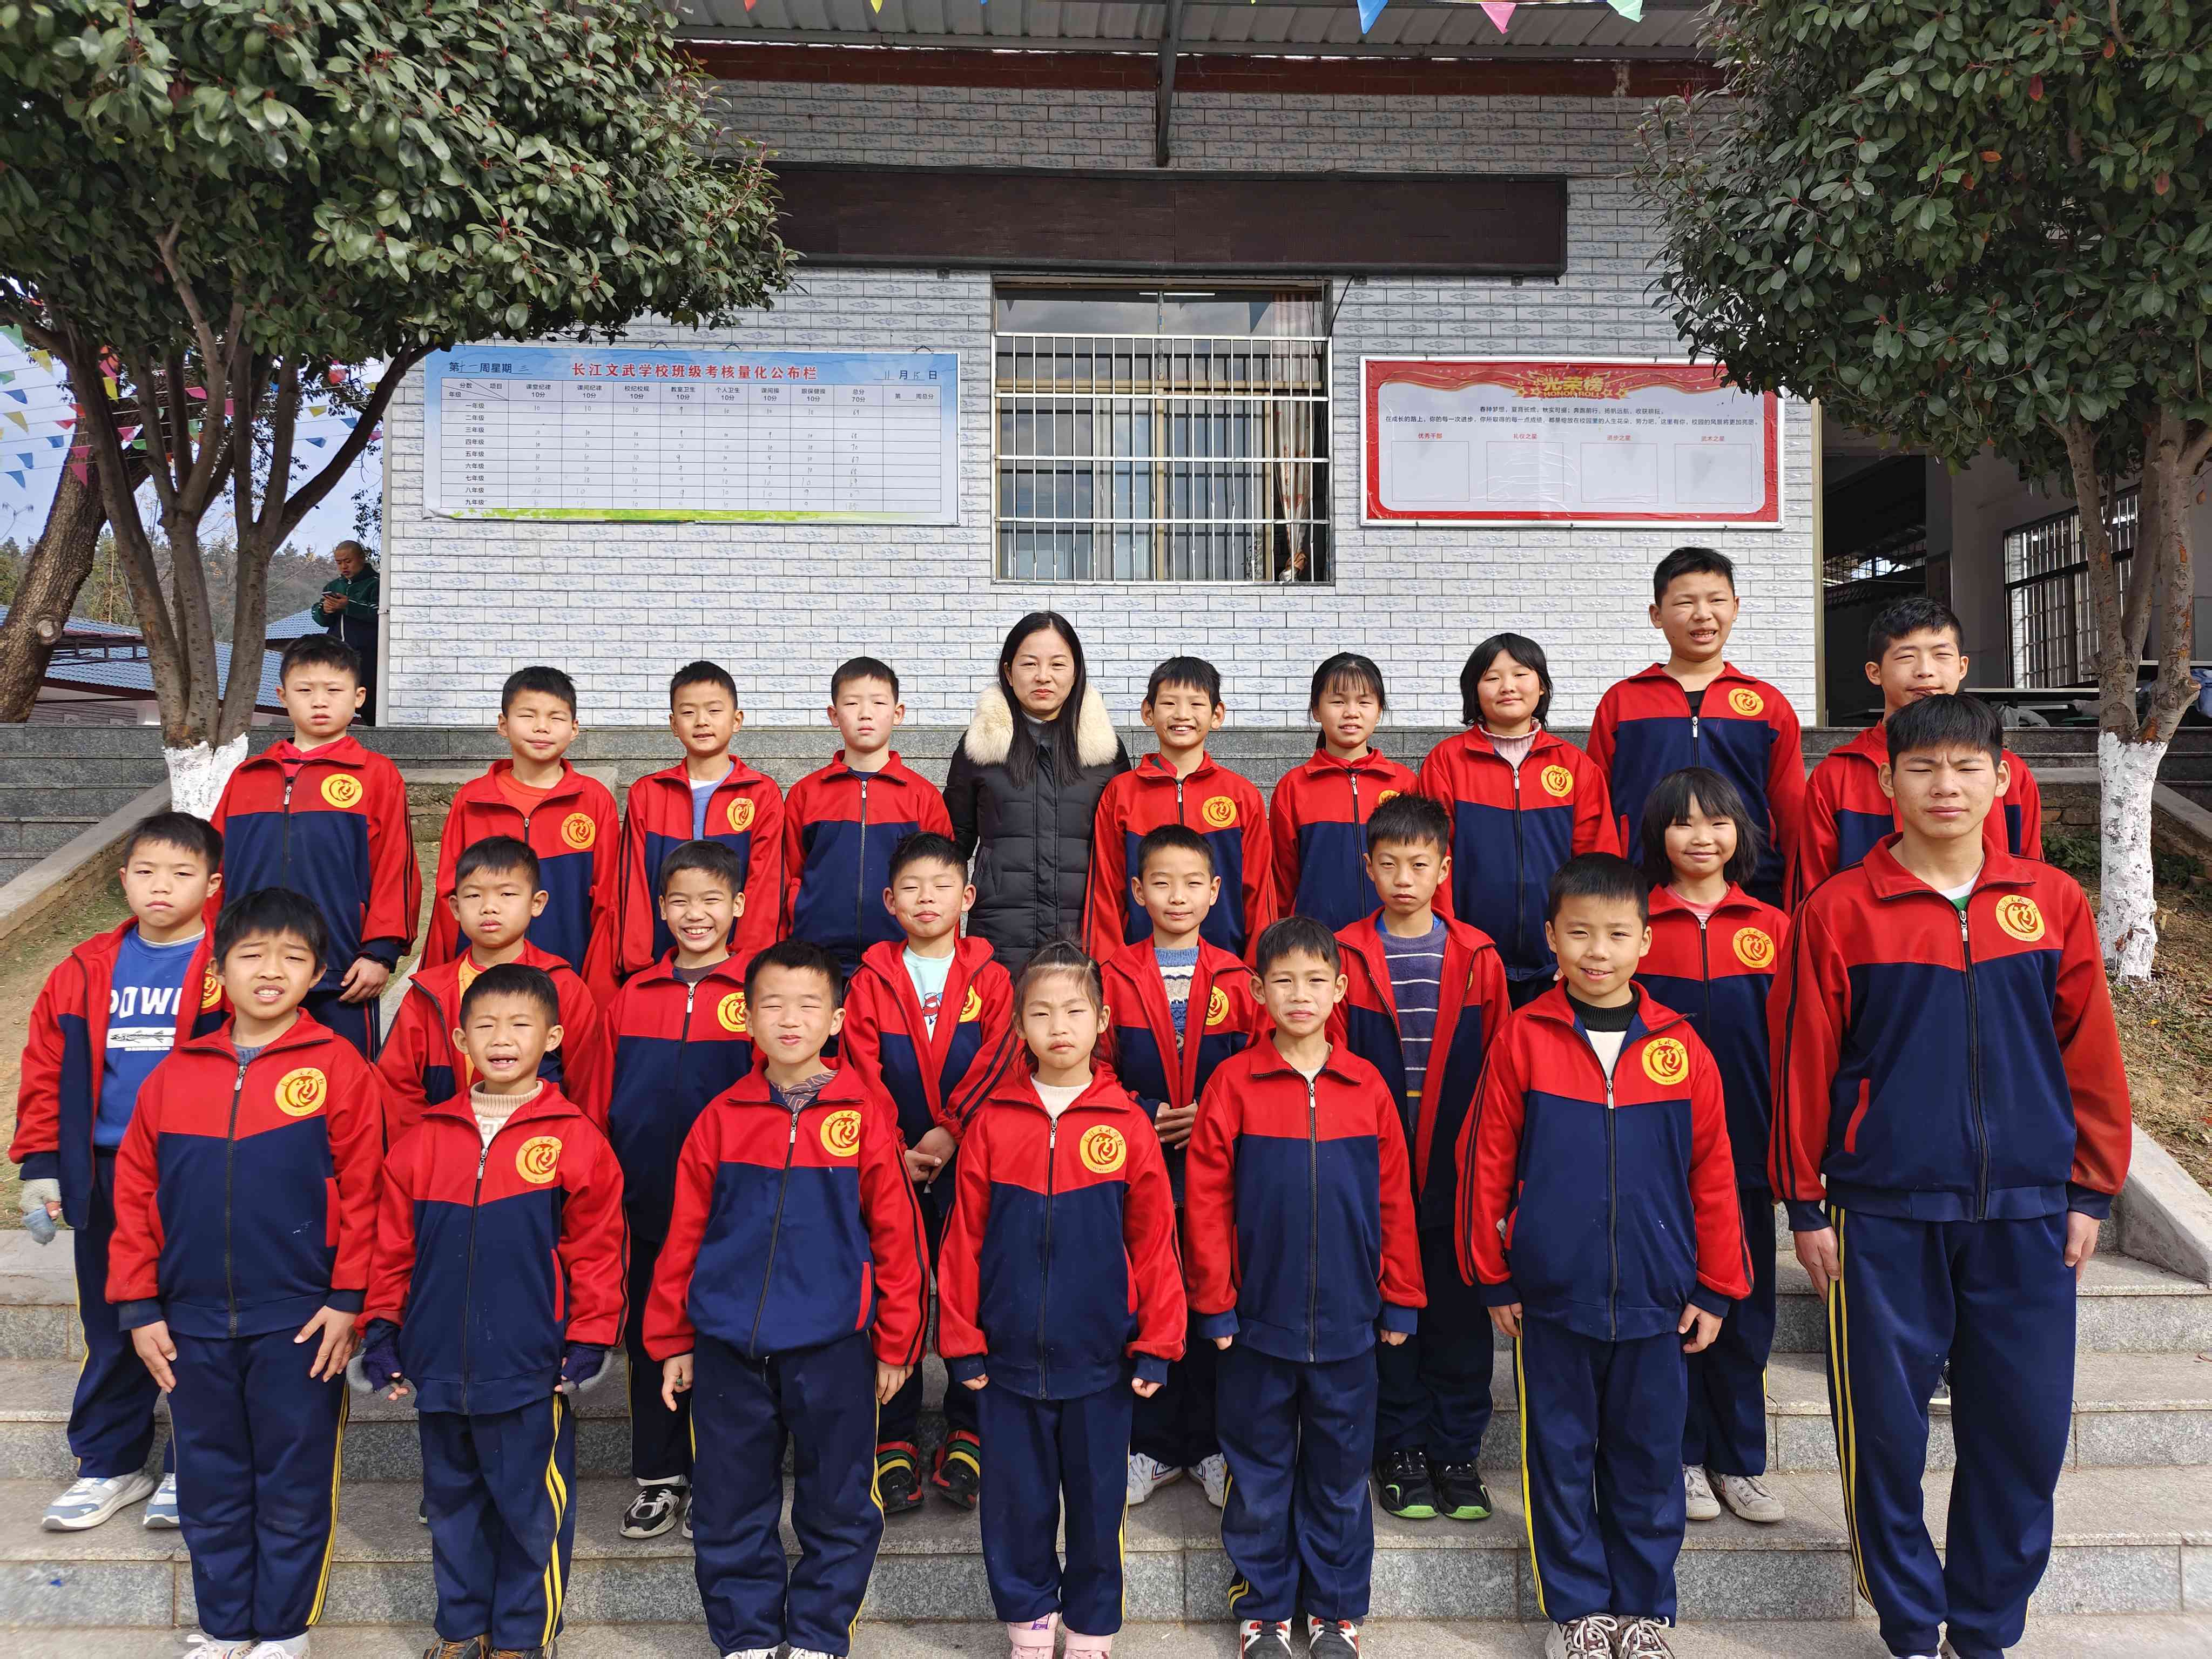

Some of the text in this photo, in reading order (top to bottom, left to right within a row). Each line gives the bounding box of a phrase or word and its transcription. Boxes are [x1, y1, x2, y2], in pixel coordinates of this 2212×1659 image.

[572, 362, 817, 380] 长江文武学校班级考核量化公布栏
